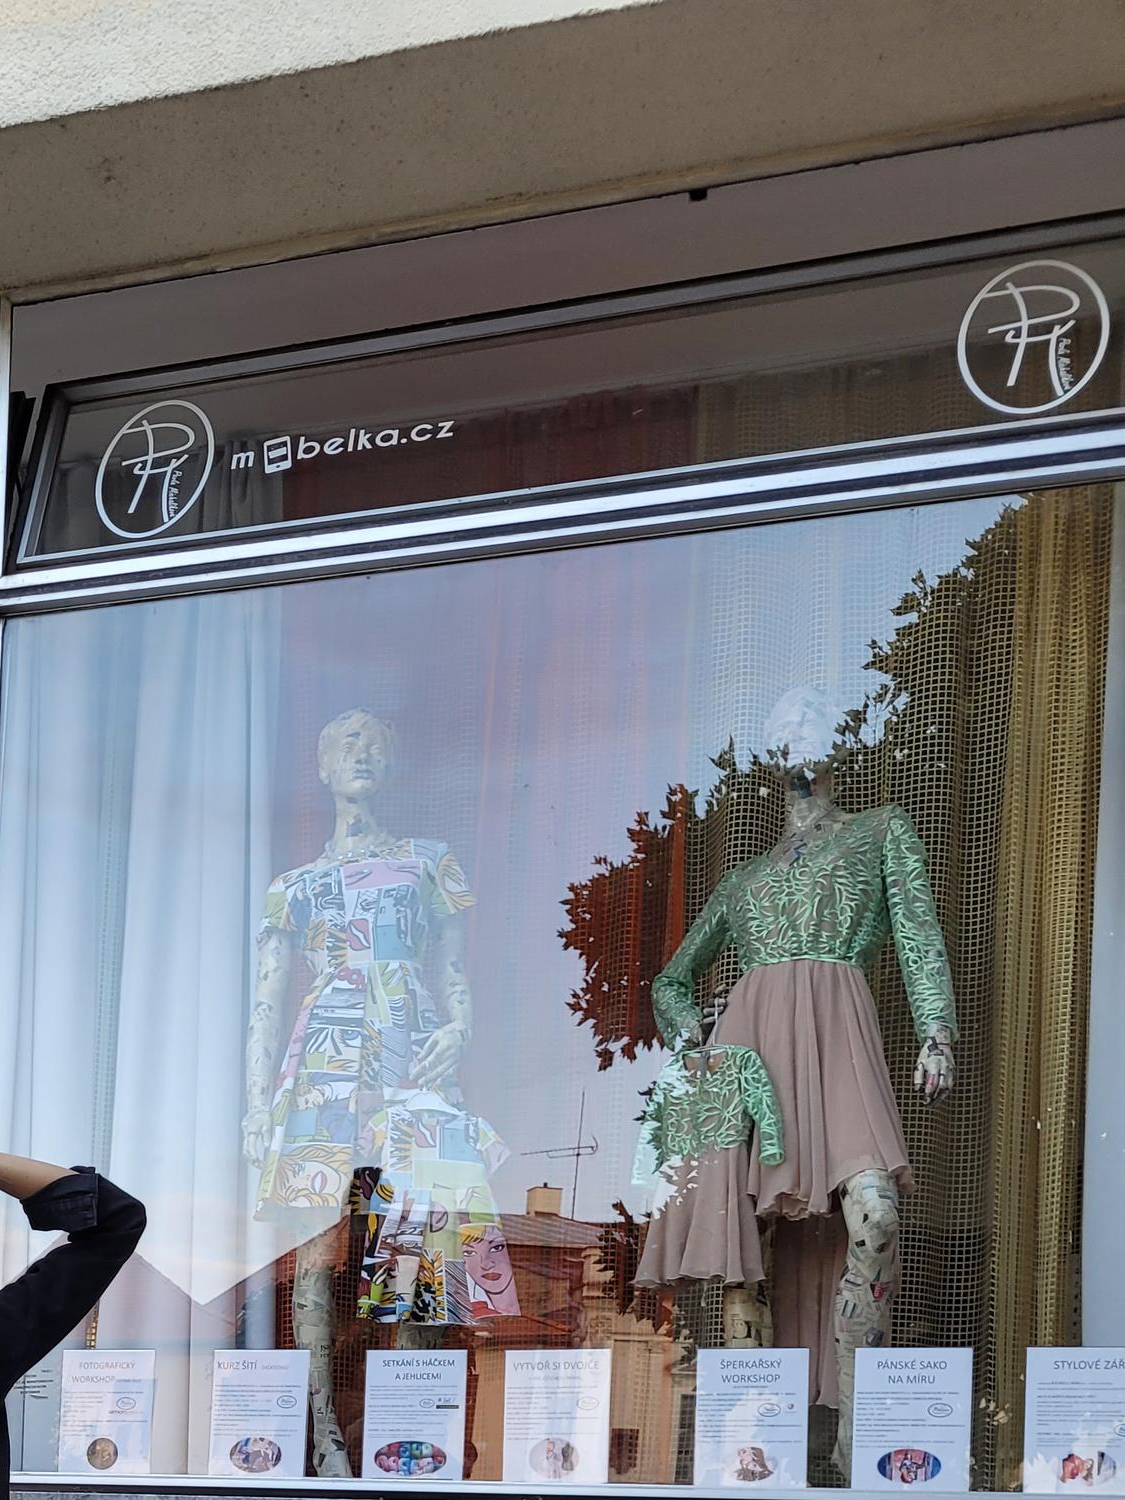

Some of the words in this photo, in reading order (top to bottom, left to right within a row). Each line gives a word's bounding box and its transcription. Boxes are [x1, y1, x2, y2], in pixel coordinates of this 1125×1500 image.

[217, 1361, 240, 1370] KURZ
[415, 1359, 421, 1367] S
[877, 1358, 917, 1370] PÁNSKÉ
[919, 1360, 948, 1370] SAKO
[1053, 1358, 1101, 1370] STYLOVÉ
[394, 1372, 401, 1380] A
[721, 1374, 781, 1383] WORKSHOP
[888, 1375, 904, 1384] NA
[906, 1372, 936, 1384] MÍRU
